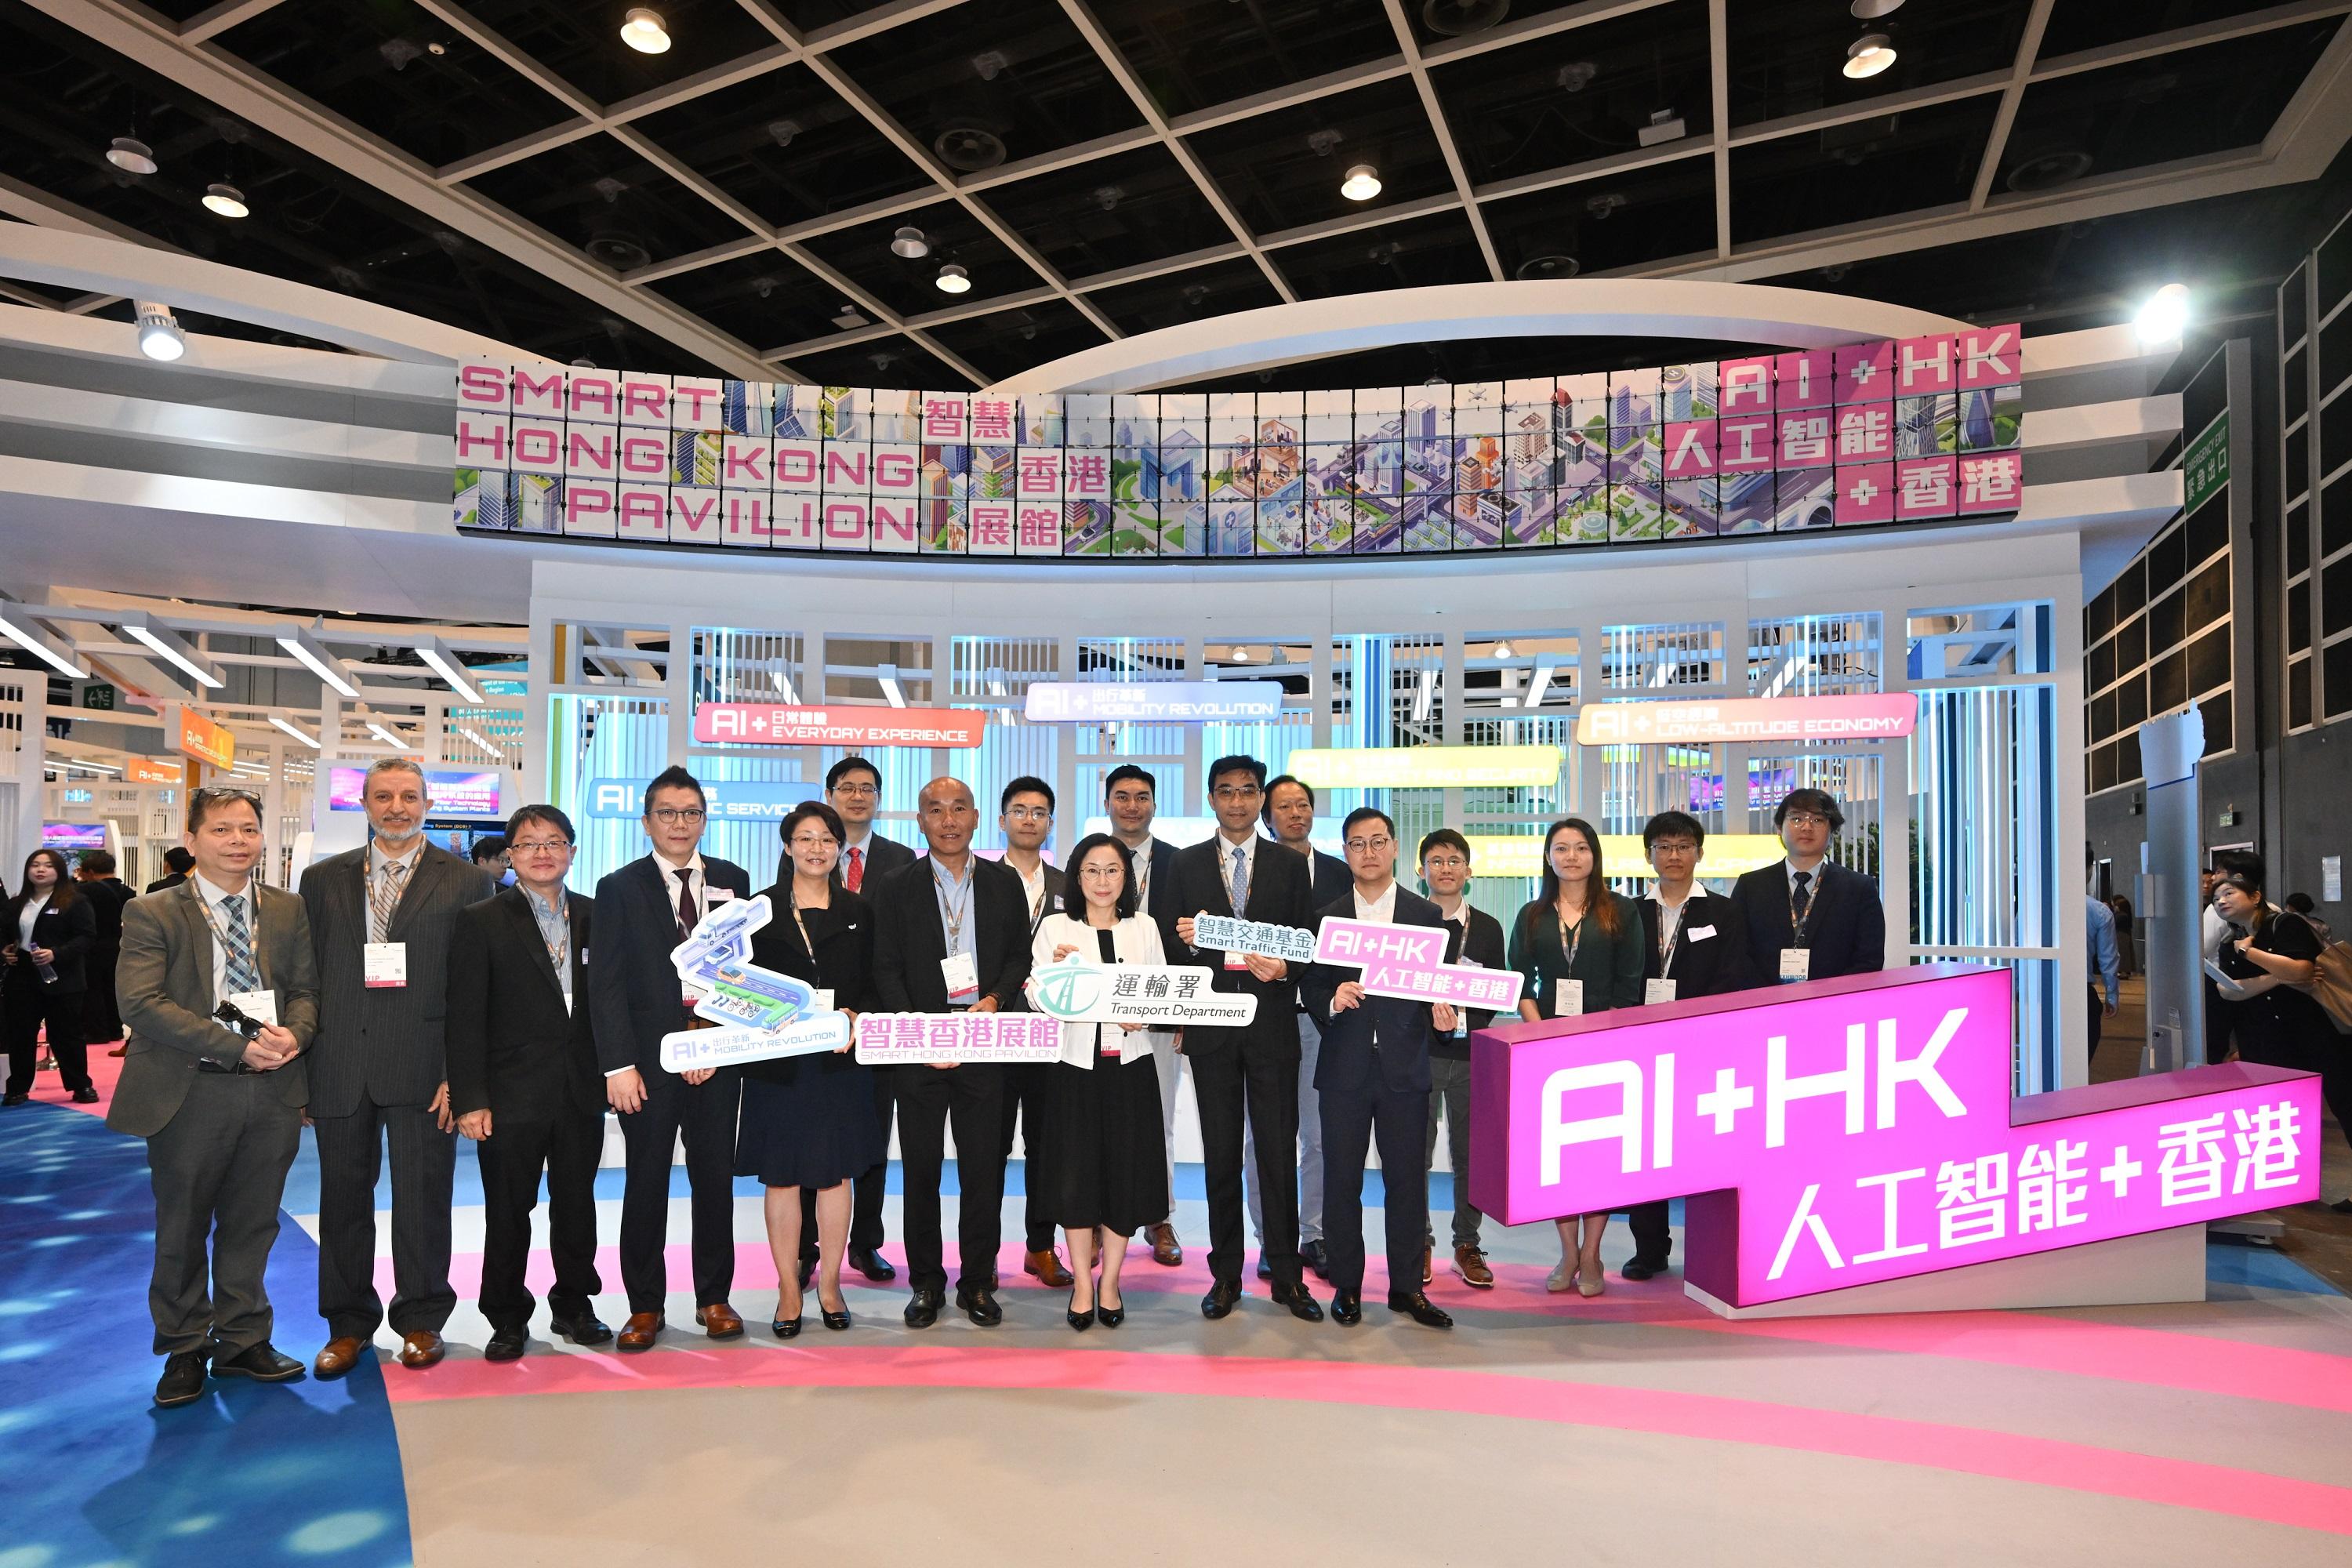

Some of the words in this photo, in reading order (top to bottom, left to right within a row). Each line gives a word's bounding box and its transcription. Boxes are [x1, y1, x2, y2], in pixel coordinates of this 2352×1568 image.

[461, 365, 717, 420] SMART
[926, 399, 1011, 441] 智慧
[459, 420, 666, 476] HONG
[728, 443, 916, 488] KONG
[1667, 412, 1889, 473] 人工智能
[2187, 437, 2215, 475] EMERGENCY
[2215, 426, 2226, 448] EXIT
[1021, 455, 1106, 495] 香港
[1849, 457, 2022, 512] +香港
[2187, 447, 2227, 502] 緊急出口
[567, 486, 914, 543] PAVILION
[971, 507, 1058, 548] 展館
[1093, 703, 1165, 715] MOBILITY
[1170, 702, 1274, 715] REVOLUTION
[773, 727, 864, 740] EVERYDAY
[869, 728, 968, 742] EXPERIENCE
[1657, 718, 1799, 737] LOW-ALTITUDE
[1805, 717, 1904, 733] ECONOMY
[1197, 916, 1312, 949] 智慧交通基金
[1198, 934, 1236, 949] Smart
[1238, 939, 1276, 954] Traffic
[1279, 946, 1310, 959] Fund
[1328, 930, 1430, 963] AI+HK
[1112, 973, 1201, 999] 運輸署
[1372, 967, 1509, 1001] 人工智能+香港
[1111, 1003, 1169, 1018] Transport
[1172, 1004, 1247, 1020] Department
[713, 1033, 750, 1047] 出行革新
[714, 1042, 764, 1054] MOBILITY
[767, 1031, 836, 1047] REVOLUTION
[860, 1018, 1058, 1048] 智慧香港展館
[861, 1051, 909, 1059] SMART
[913, 1050, 951, 1058] HONG
[954, 1050, 992, 1058] KONG
[995, 1050, 1057, 1058] PAVILION
[1540, 1007, 1969, 1187] AI+HK
[1767, 1101, 2302, 1281] 人工智能+香港
